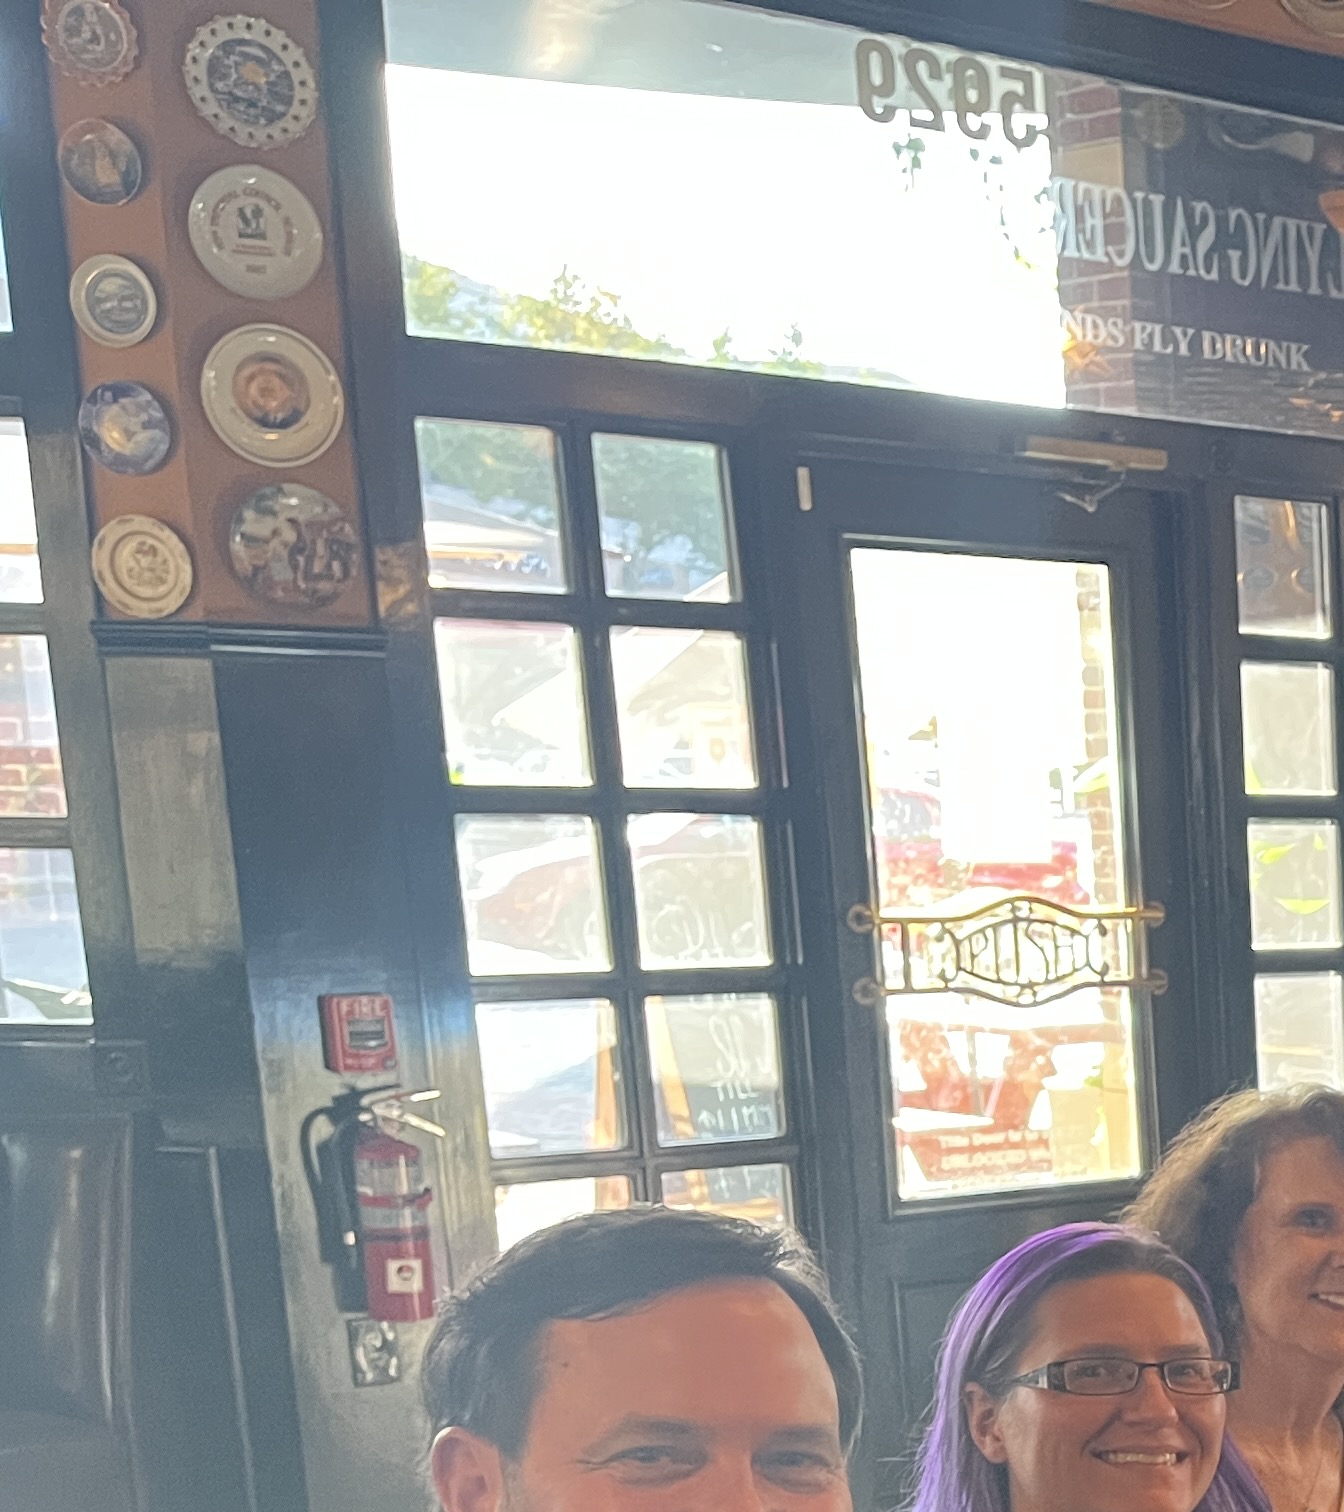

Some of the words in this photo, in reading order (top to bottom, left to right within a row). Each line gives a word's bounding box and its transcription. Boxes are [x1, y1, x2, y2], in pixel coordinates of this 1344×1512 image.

[1131, 324, 1195, 358] FLY
[1201, 330, 1312, 372] DRUNK
[967, 917, 1076, 985] PUSH
